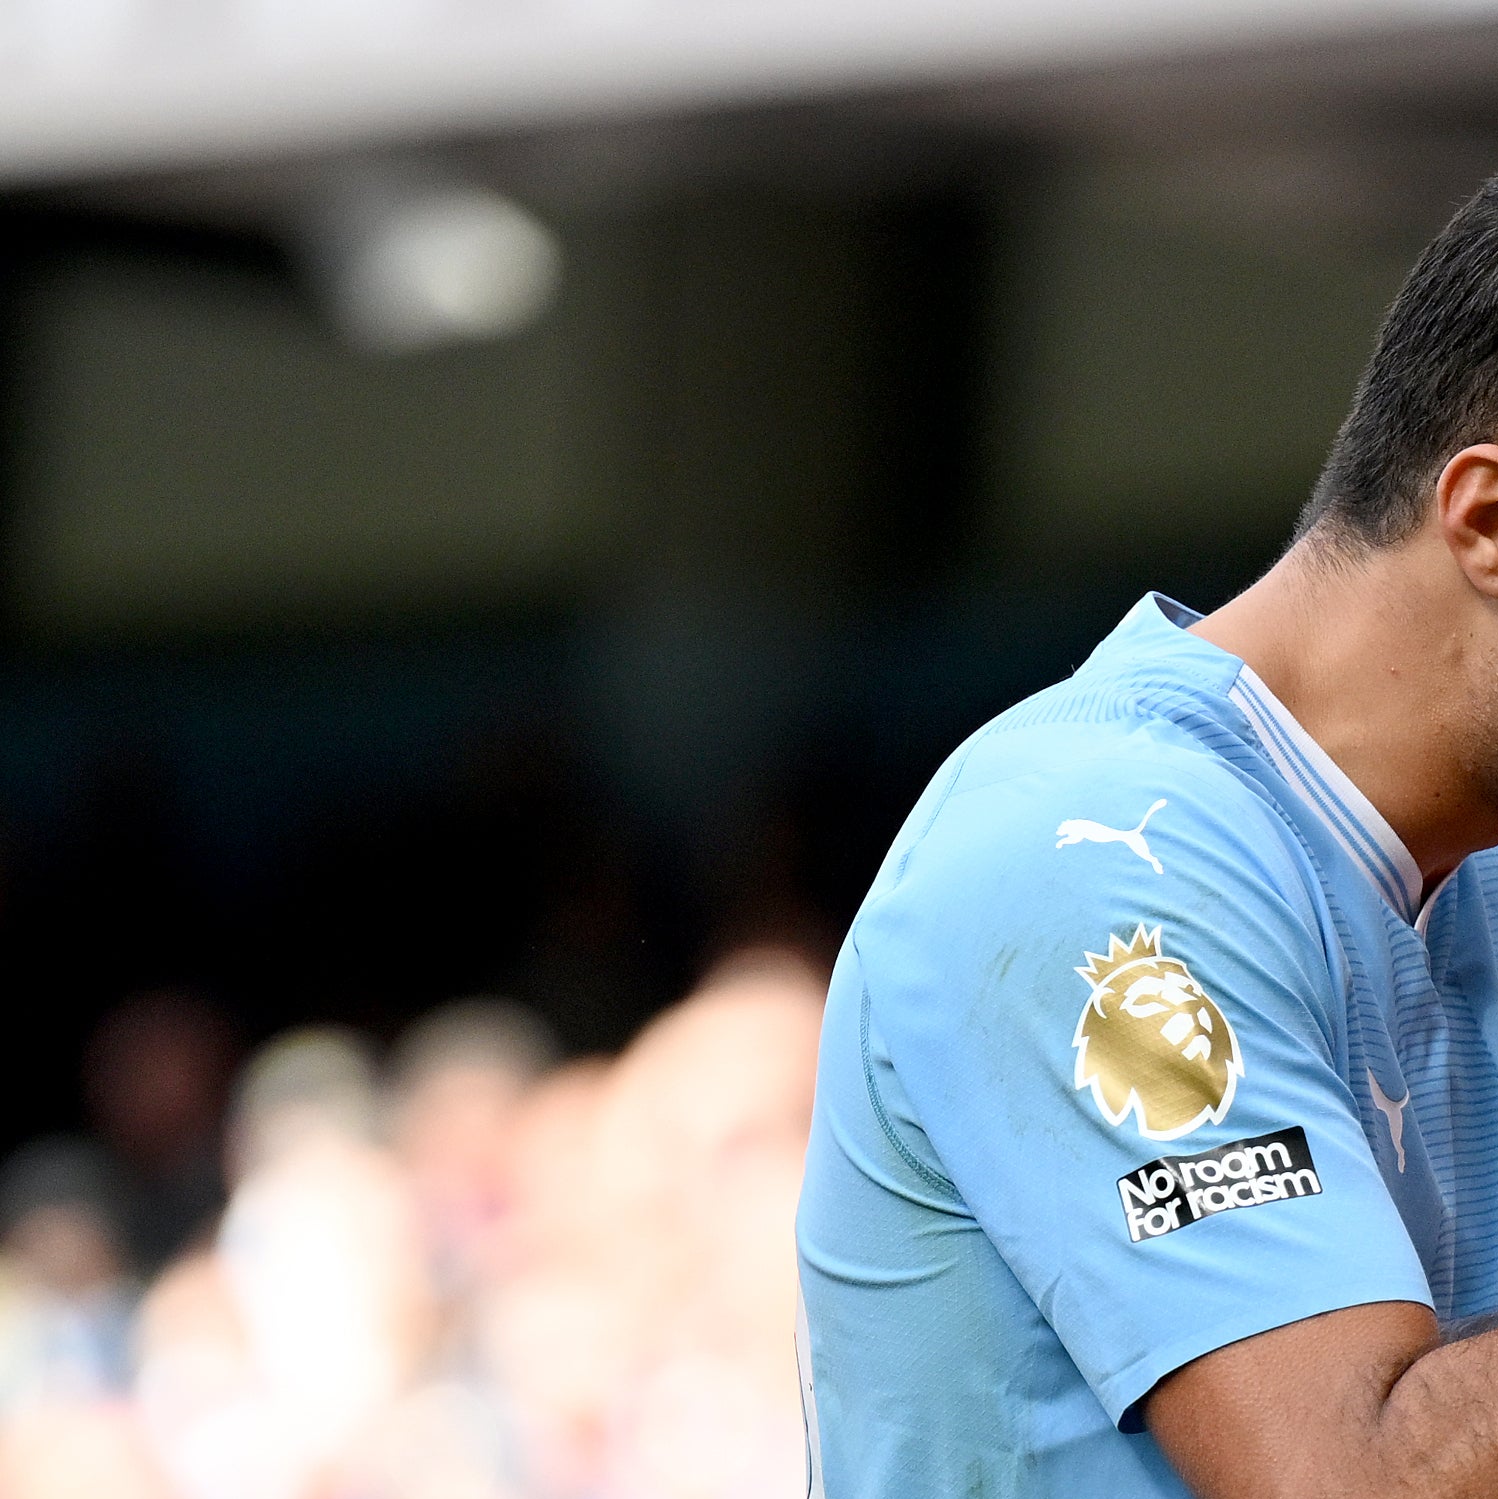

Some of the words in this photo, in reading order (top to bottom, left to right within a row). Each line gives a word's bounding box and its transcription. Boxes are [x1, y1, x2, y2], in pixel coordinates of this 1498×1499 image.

[1118, 1168, 1175, 1214] No
[1178, 1141, 1293, 1188] room
[1126, 1196, 1182, 1242] for
[1186, 1167, 1322, 1219] racism
